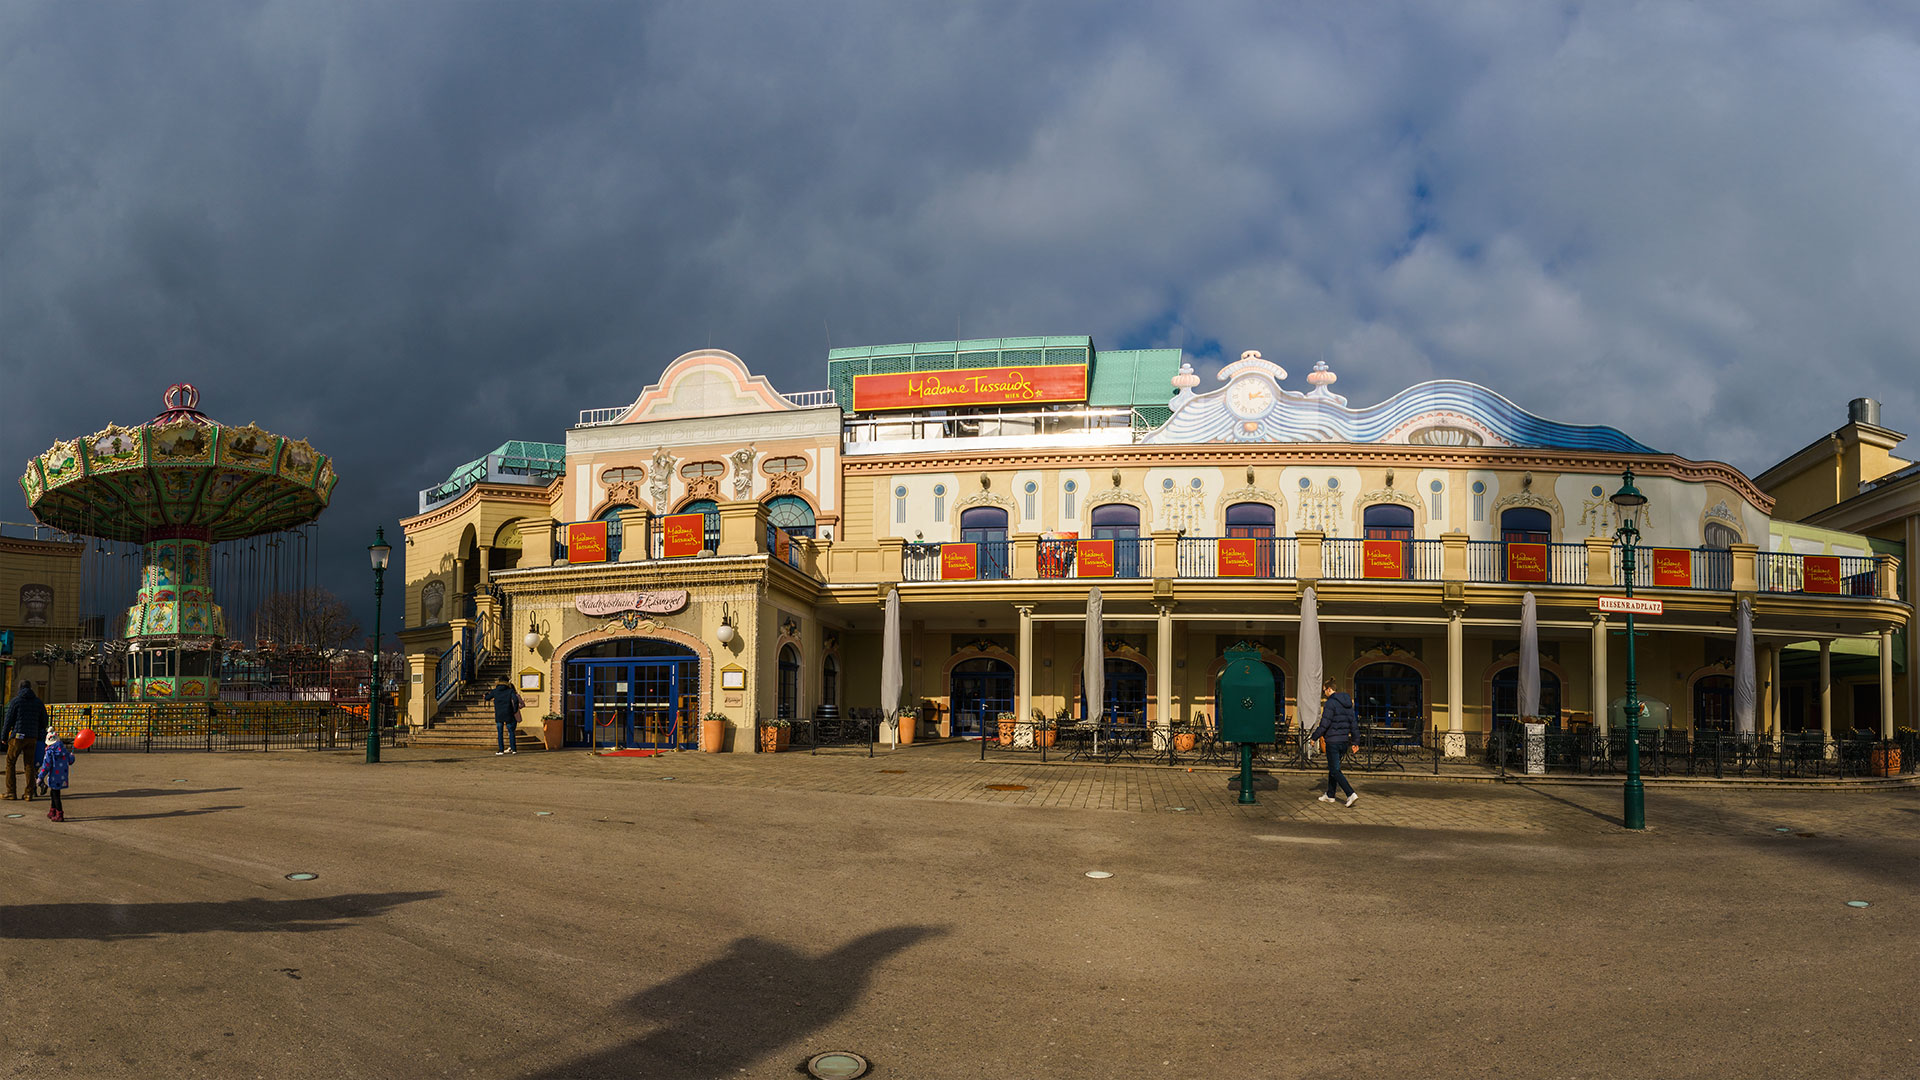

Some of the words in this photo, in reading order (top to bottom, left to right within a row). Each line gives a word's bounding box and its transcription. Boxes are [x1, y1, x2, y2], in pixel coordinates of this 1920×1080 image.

[908, 377, 969, 398] Madame
[965, 371, 1034, 399] Tussauds
[668, 525, 693, 535] Madame
[572, 533, 596, 542] Madame
[578, 597, 635, 612] Stadtgasthaus
[1601, 600, 1661, 612] RIESENRADPLATZ
[1244, 665, 1250, 674] 2
